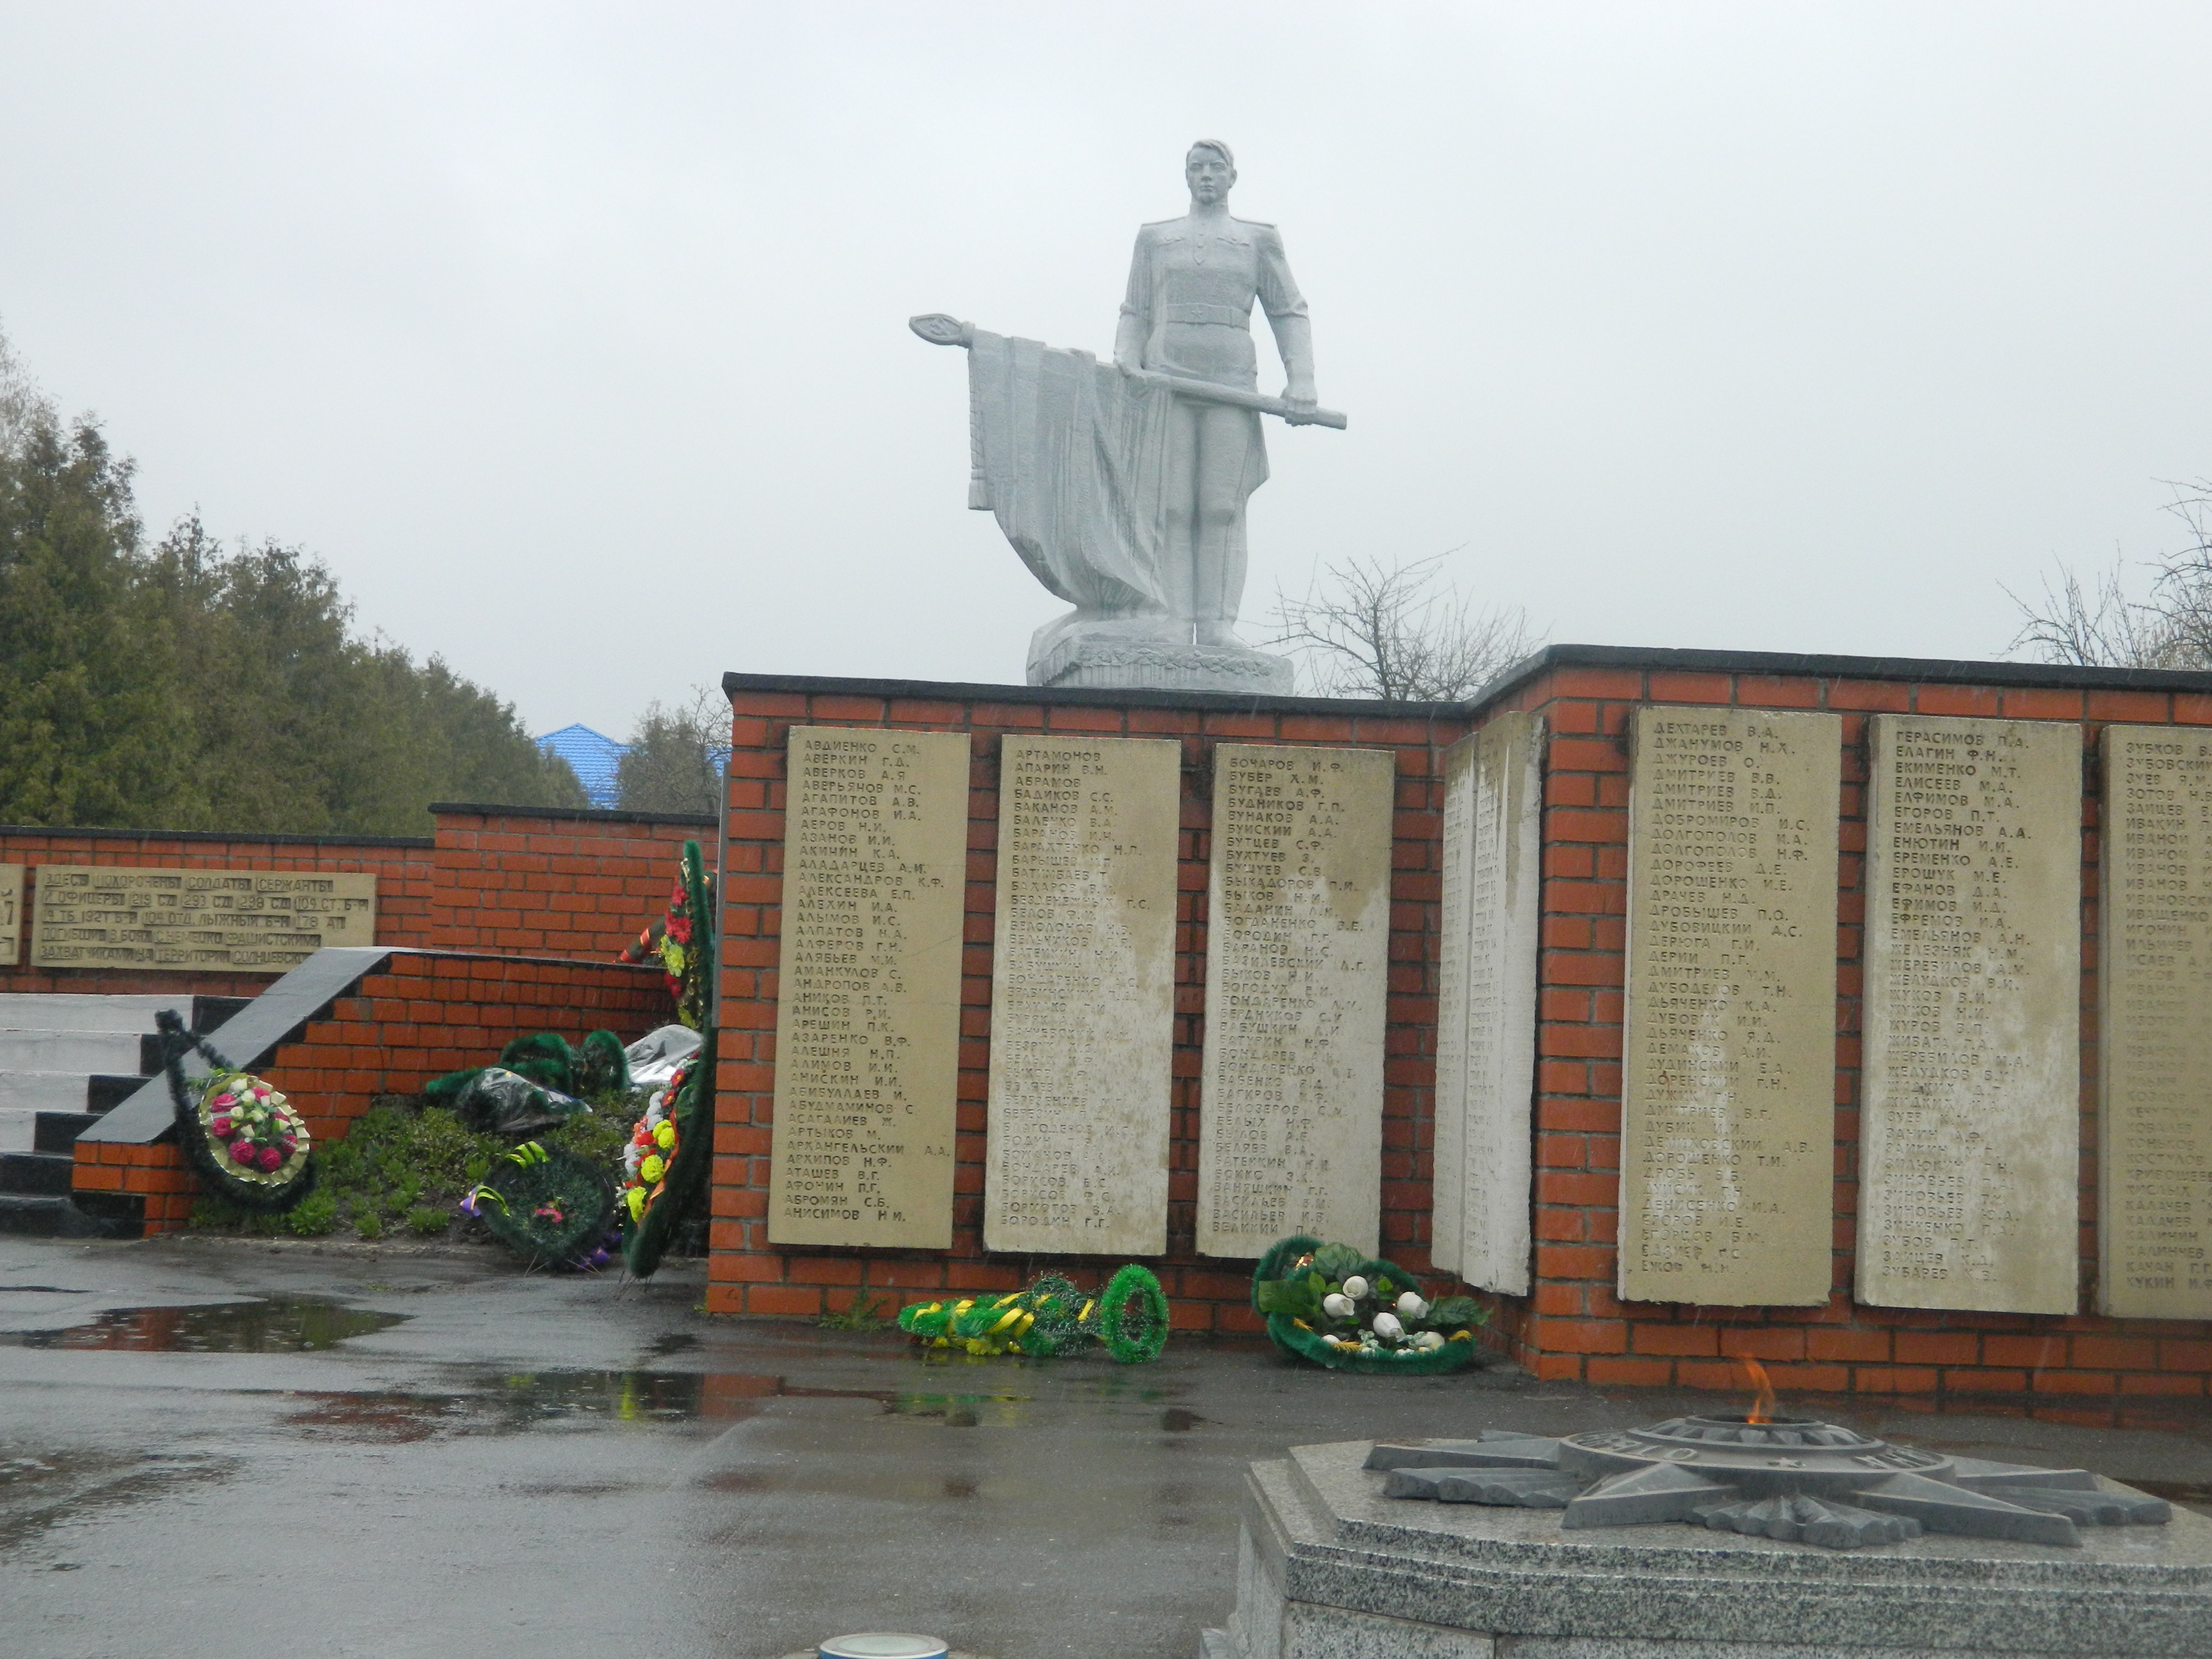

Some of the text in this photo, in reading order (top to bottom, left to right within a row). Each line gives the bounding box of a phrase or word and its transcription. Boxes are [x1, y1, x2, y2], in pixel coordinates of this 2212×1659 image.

[1653, 737, 1742, 751] ДЖАНУМОВ
[1896, 730, 1984, 745] ГЕРАСИМОВ
[805, 739, 877, 752] АВДИЕНКО
[1896, 745, 1954, 758] ЕЛАГИН
[803, 752, 867, 765] АВЕРКИН
[1016, 749, 1100, 761] АРТАМОНОВ
[1230, 757, 1294, 770] БОЧАРОВ
[1896, 760, 1976, 775] ЕКИМЕНКО
[803, 765, 865, 778] АВЕРКОВ
[1229, 770, 1272, 782] БУБЕР
[2126, 772, 2160, 784] ЗУЕВ
[803, 779, 883, 792] АВЕРЬЯНОВ
[1895, 775, 1960, 789] ЕЛИСЕЕВ
[1014, 789, 1079, 800] БАДИКОВ
[1228, 783, 1281, 796] БУГАЕВ
[2126, 786, 2175, 799] ЗОТОВ
[1228, 796, 1304, 810] БУДНИКОВ
[1895, 790, 1968, 804] ЕЛФИМОВ
[801, 805, 879, 818] АГАФОНОВ
[1228, 810, 1293, 822] БУНАКОВ
[1895, 805, 1952, 819] ЕГОРОВ
[801, 819, 845, 830] АЕРОВ
[1652, 813, 1759, 828] ДОБРОМИРОВ
[1894, 820, 1983, 836] ЕМЕЛЬЯНОВ
[800, 832, 856, 844] АЗАНОВ
[1226, 836, 1279, 848] БУТЦЕВ
[1894, 836, 1959, 850] ЕНЮТИН
[799, 845, 857, 857] АКИНИН
[1651, 843, 1756, 858] ДОЛГОПОЛОВ
[1894, 851, 1970, 866] ЕРЕМЕНКО
[1650, 859, 1733, 873] ДОРОФЕЕВ
[259, 878, 333, 892] СЕРЖАНТЫ
[799, 871, 902, 886] АЛЕКСАНДРОВ
[1650, 874, 1748, 889] ДОРОШЕНКО
[1650, 889, 1705, 902] ДРАЧЕВ
[1892, 882, 1954, 896] ЕФАНОВ
[58, 891, 125, 905] ОФИЦЕРЫ
[798, 898, 856, 910] АЛЕХИН
[796, 925, 863, 938] АЛПАТОВ
[794, 965, 878, 978] АМАНКУЛОВ
[792, 1032, 868, 1045] АЗАРЕНКО
[792, 1045, 849, 1057] АЛЕШНЯ
[791, 1059, 851, 1071] АЛИМОВ
[791, 1072, 858, 1084] АНИСКИН
[786, 1153, 849, 1165] АРХИПОВ
[786, 1166, 839, 1178] АТАШЕВ
